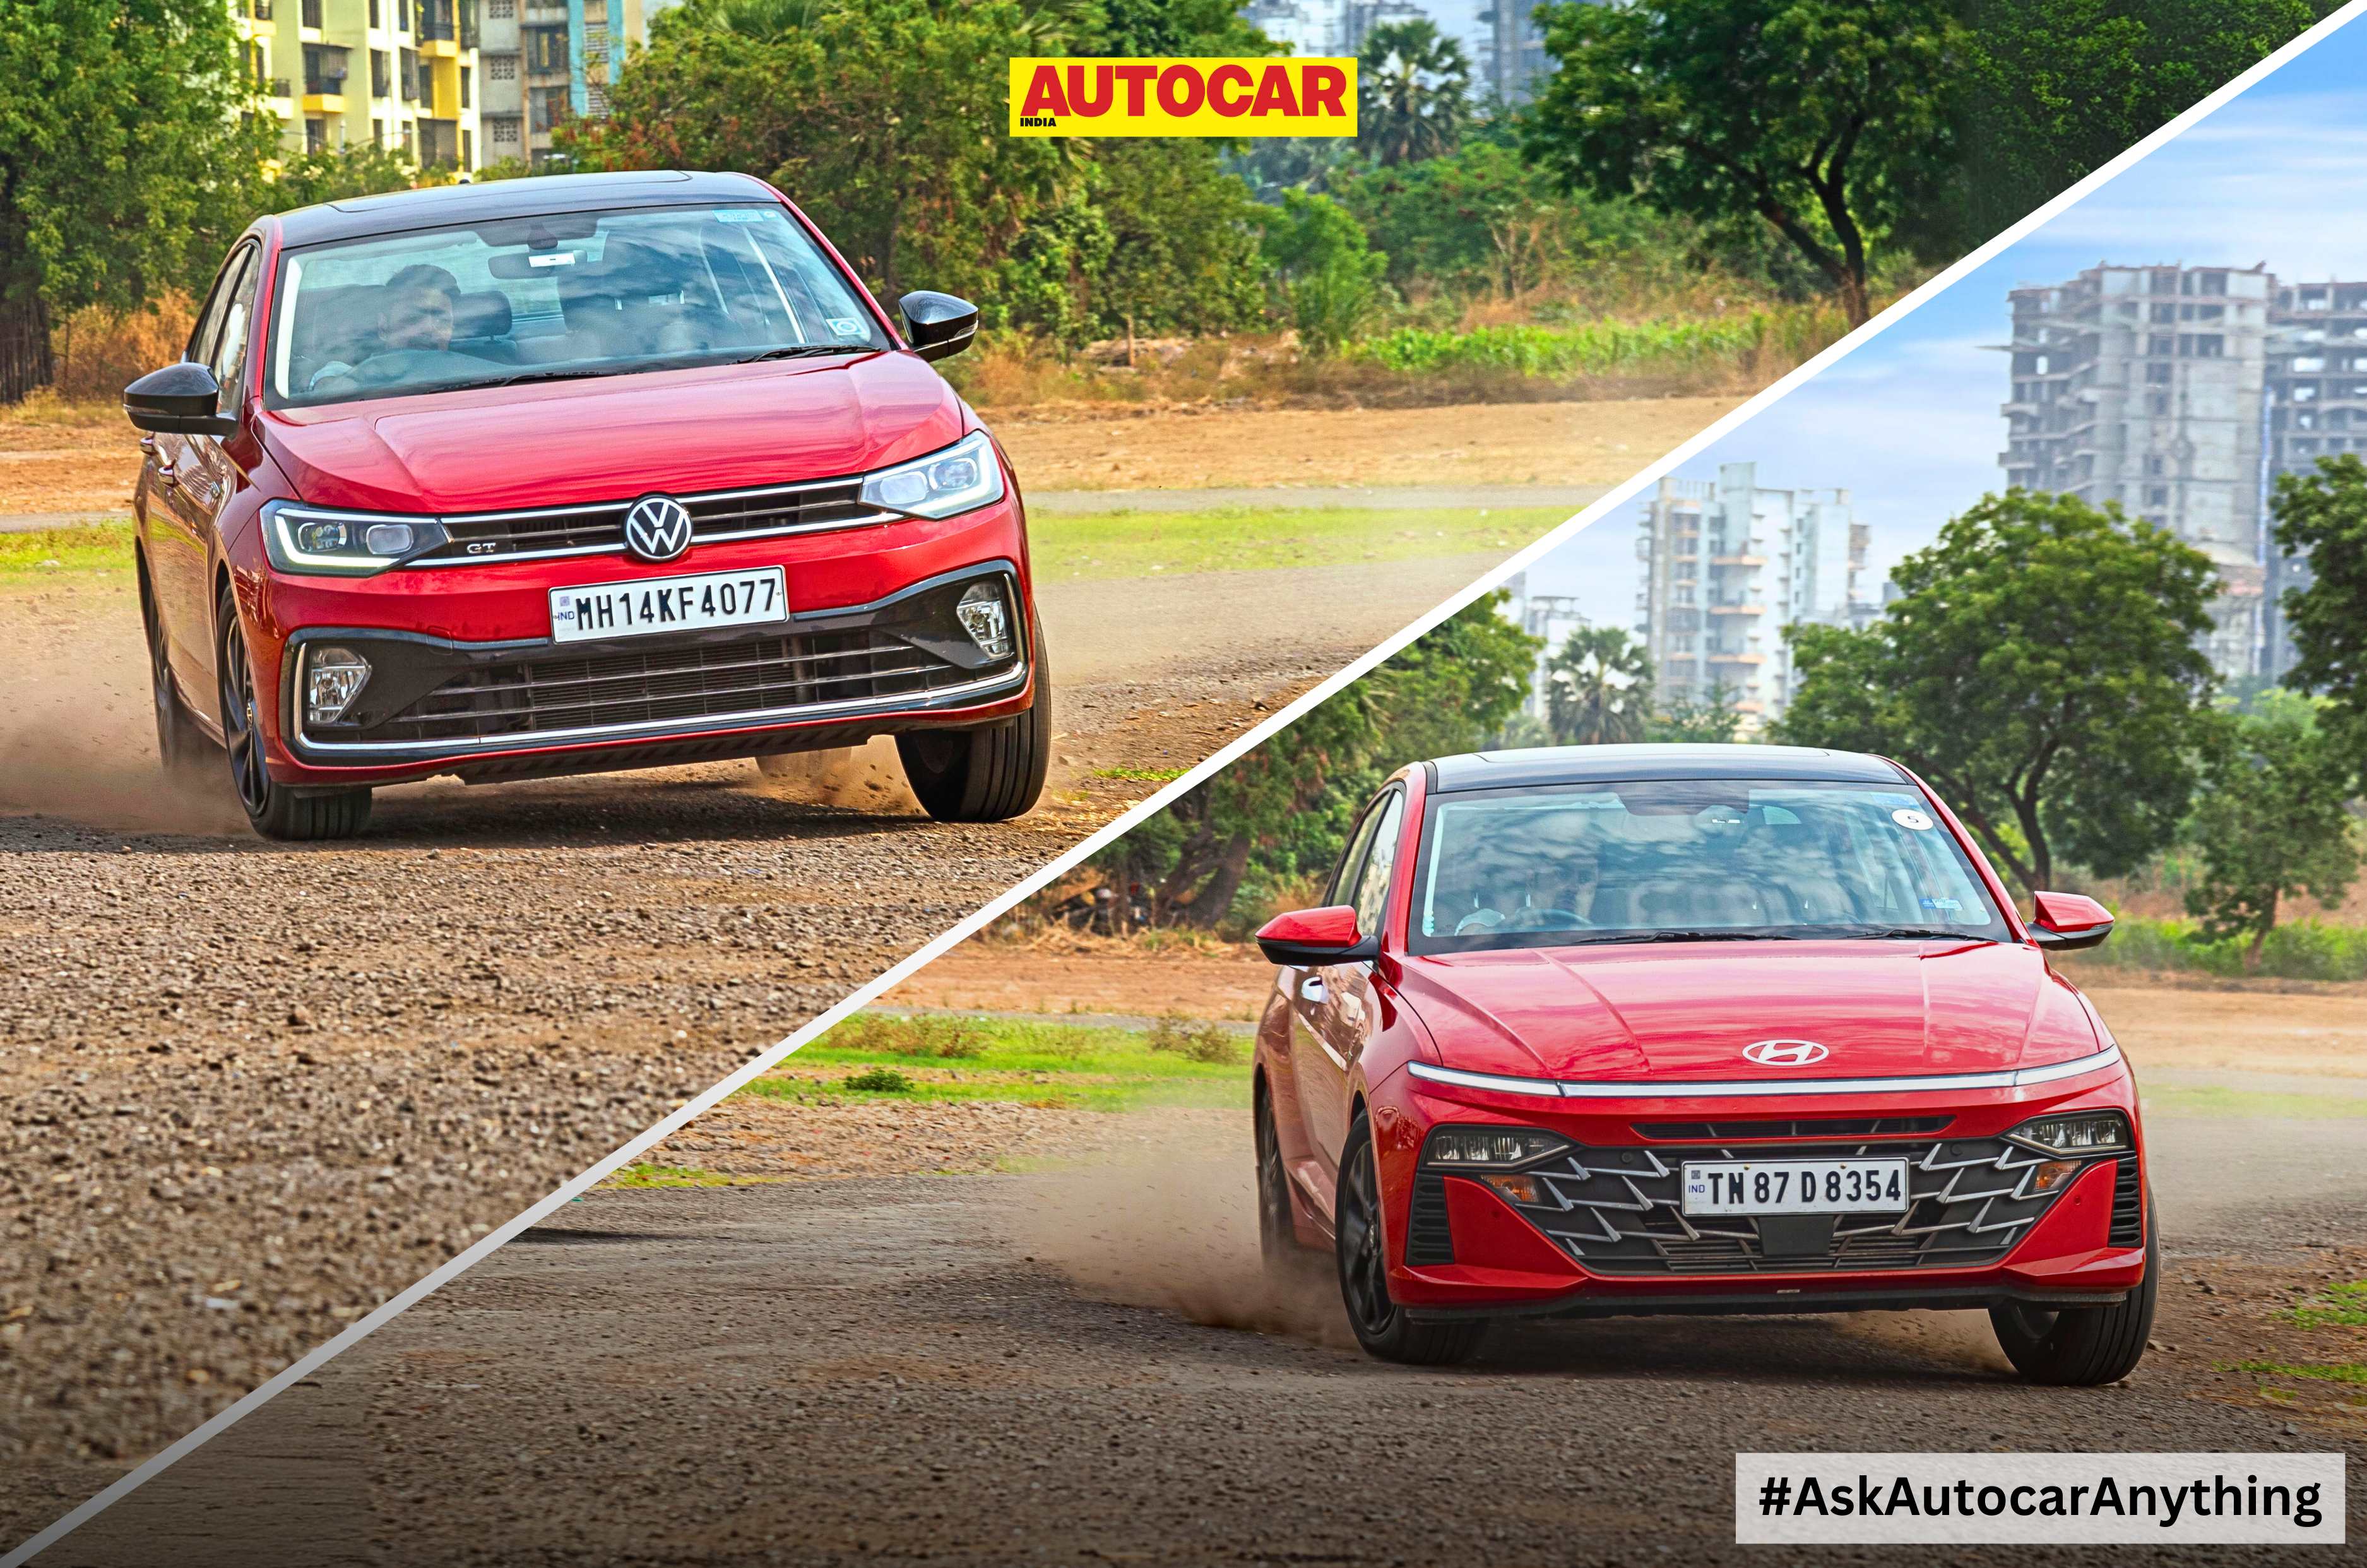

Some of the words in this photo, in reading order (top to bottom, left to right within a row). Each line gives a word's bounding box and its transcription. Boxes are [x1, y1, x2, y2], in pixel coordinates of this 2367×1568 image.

[467, 543, 496, 554] GT
[576, 579, 776, 631] MH14KF4077
[557, 611, 574, 621] IND
[1688, 1184, 1706, 1193] IND
[1708, 1172, 1744, 1204] TN
[1754, 1172, 1789, 1204] 87
[1801, 1171, 1817, 1203] D
[1825, 1169, 1901, 1202] 8354
